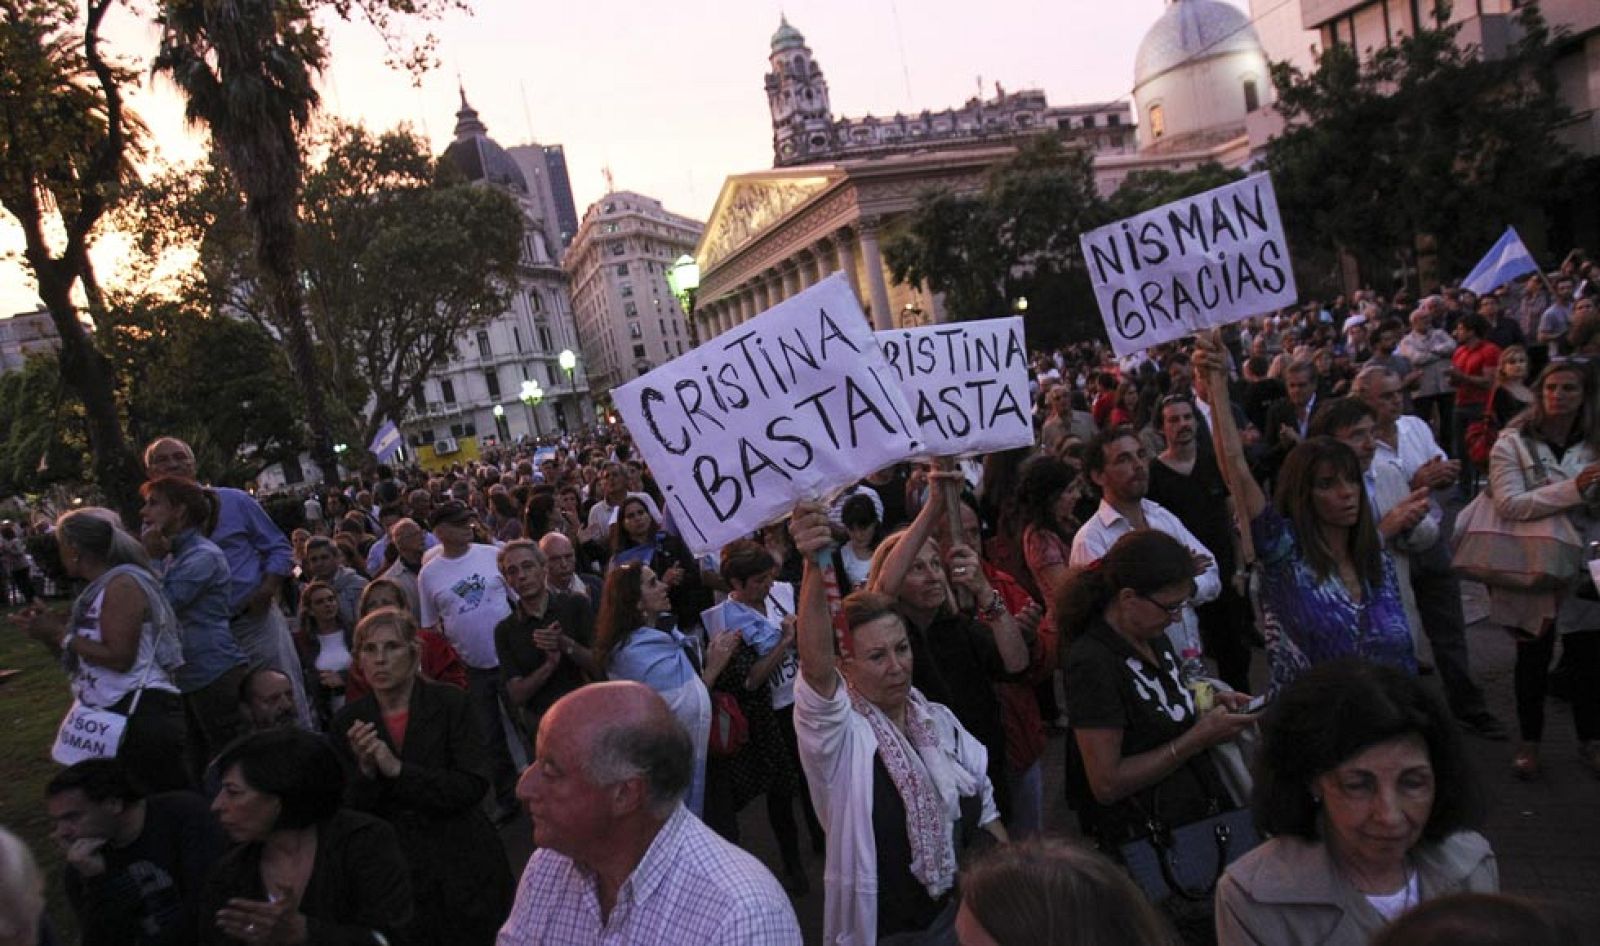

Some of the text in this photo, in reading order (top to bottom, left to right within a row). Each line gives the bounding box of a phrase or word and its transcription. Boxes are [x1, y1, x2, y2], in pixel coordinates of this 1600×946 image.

[1090, 184, 1268, 284] NISMAN
[1111, 239, 1286, 340] GRACIAS
[639, 307, 859, 456] CRISTINA
[883, 327, 1028, 382] RISTINA
[915, 379, 1028, 440] ASTA
